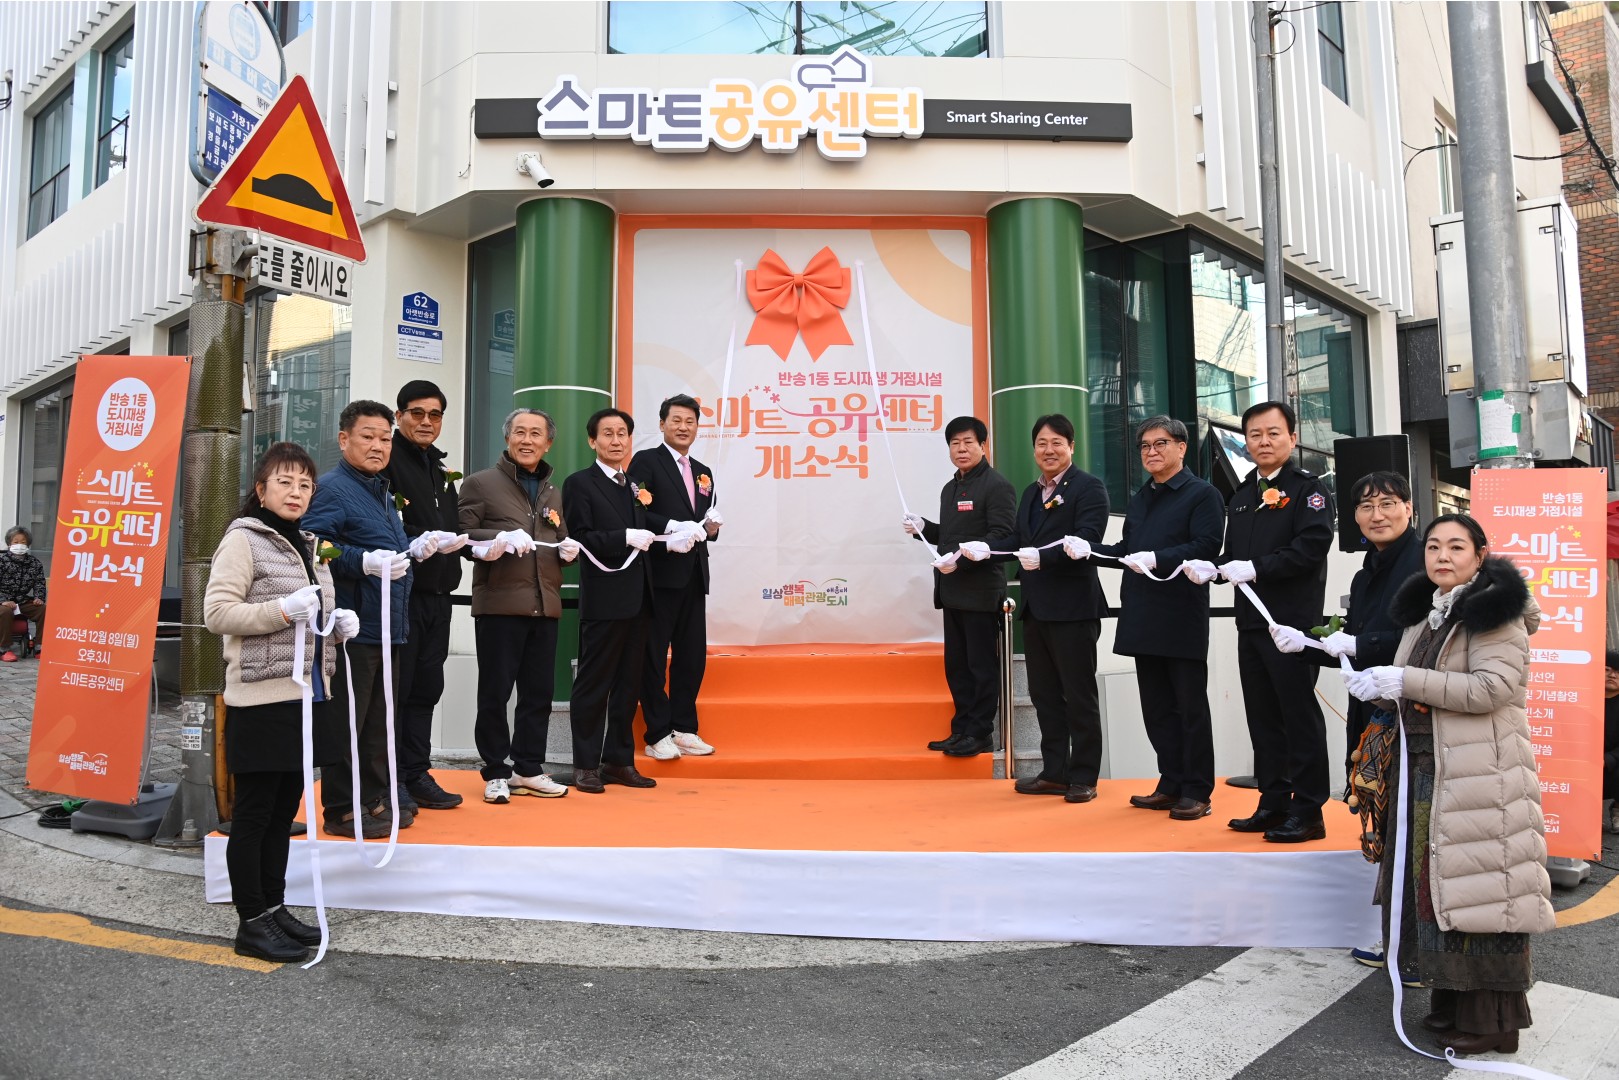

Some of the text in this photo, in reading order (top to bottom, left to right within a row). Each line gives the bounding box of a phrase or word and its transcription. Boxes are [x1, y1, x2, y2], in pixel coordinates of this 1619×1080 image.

[946, 111, 1089, 127] Smart Sharing Center
[291, 250, 348, 298] 줄이시오
[413, 295, 428, 308] 62
[833, 371, 888, 387] 도시재생
[890, 371, 943, 387] 거점시설
[106, 407, 146, 422] 도시재생
[806, 392, 943, 442] 공유센터
[104, 421, 144, 437] 거점시설
[753, 445, 869, 480] 개소식
[76, 469, 163, 506] 스마트
[1542, 492, 1583, 504] 반송1동
[1493, 505, 1583, 517] 도시재생 거점시설
[66, 507, 162, 548] 공유센터
[1490, 531, 1598, 564] 스마트
[66, 551, 145, 587] 개소식
[782, 584, 805, 595] 행복
[805, 591, 827, 603] 관광
[783, 595, 848, 607] 매력 도시
[55, 626, 139, 649] 2025년 12월 8일(월)
[1540, 651, 1559, 662] 식순
[60, 671, 125, 693] 스마트공유센터
[1536, 689, 1578, 703] 기념촬영
